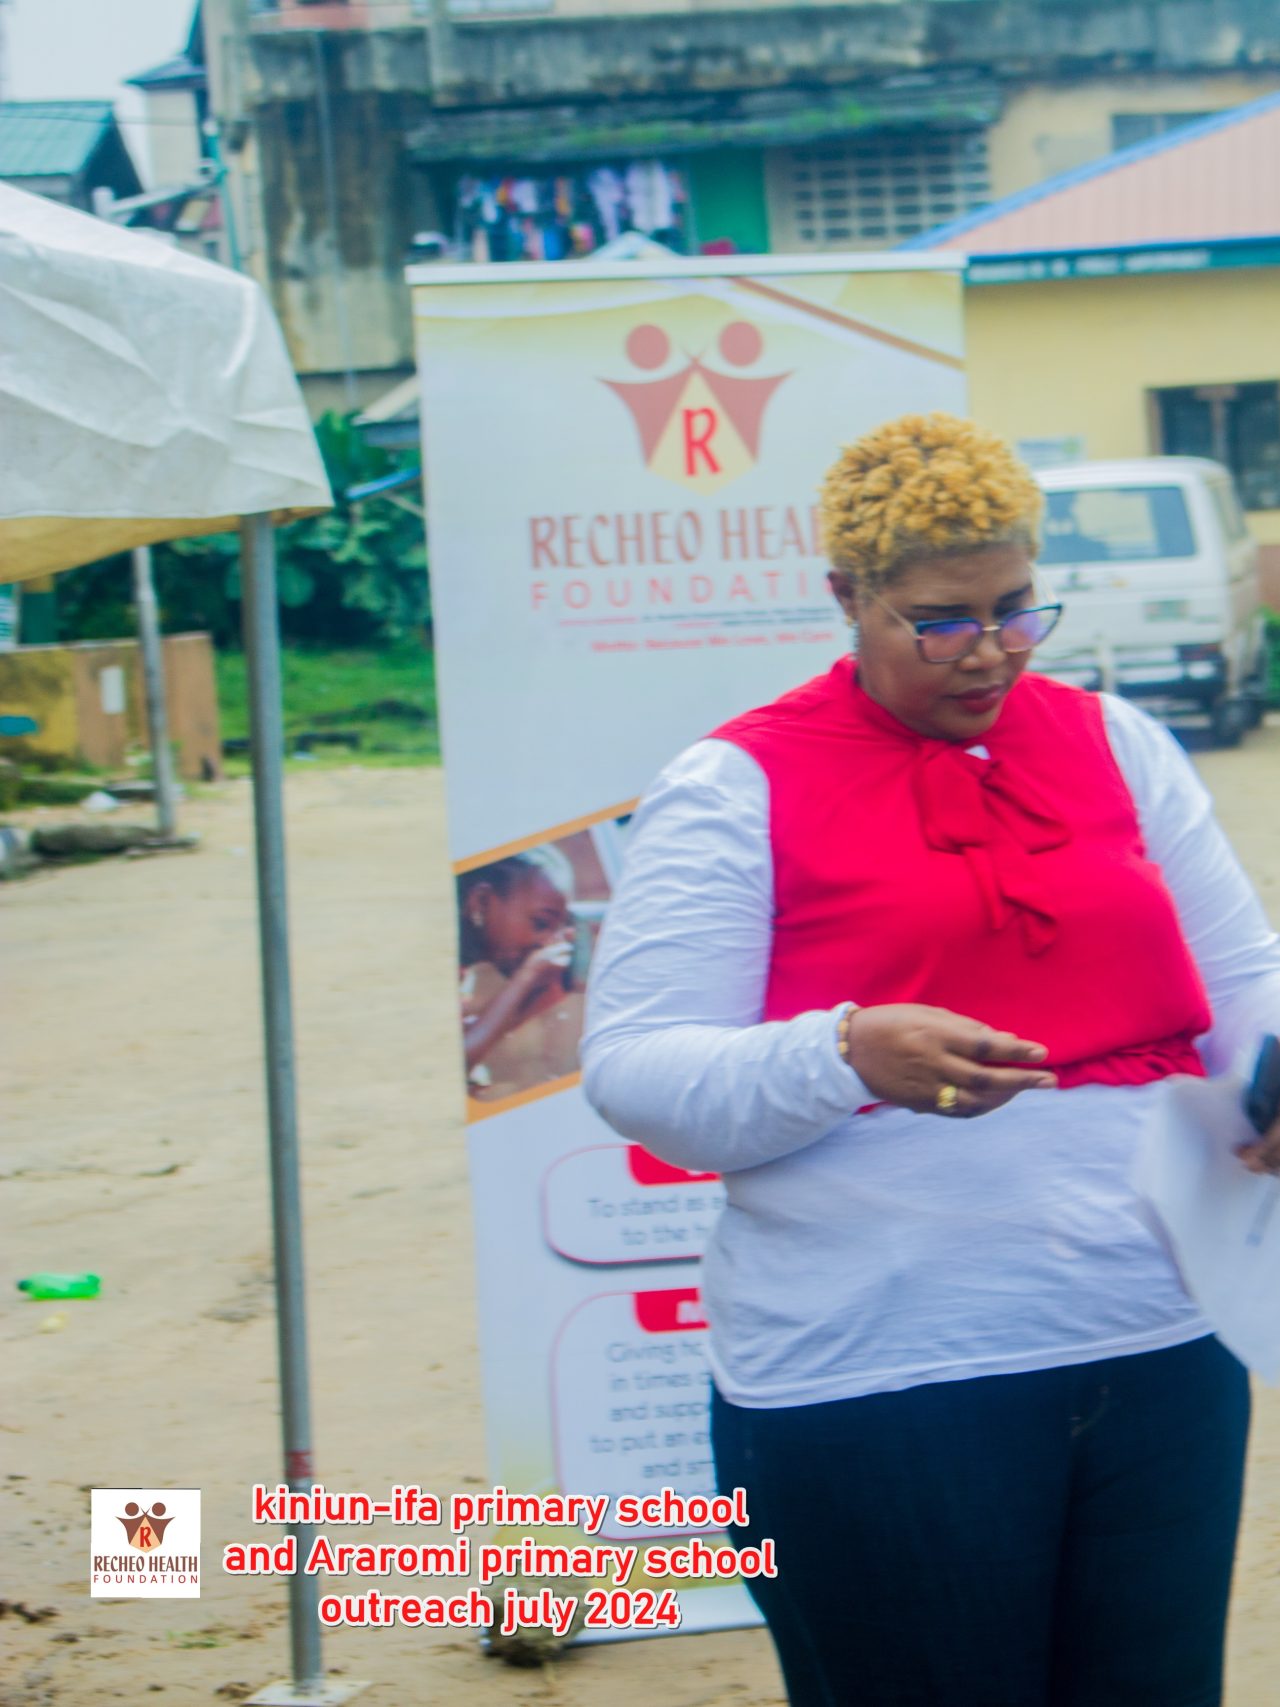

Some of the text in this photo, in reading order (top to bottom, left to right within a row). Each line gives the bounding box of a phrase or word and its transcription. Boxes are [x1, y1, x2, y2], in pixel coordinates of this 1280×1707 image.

[683, 407, 721, 477] R
[529, 505, 826, 570] RECHEO HEAL
[530, 570, 834, 609] FOUNDATI
[587, 1197, 617, 1218] To
[620, 1195, 680, 1216] stand
[620, 1226, 648, 1246] to
[652, 1223, 690, 1244] the
[606, 1341, 677, 1365] Giving
[610, 1373, 629, 1392] in
[632, 1370, 693, 1389] times
[609, 1401, 710, 1423] and supp
[589, 1433, 616, 1454] to
[618, 1430, 658, 1456] put
[663, 1431, 688, 1448] an
[642, 1459, 682, 1479] and
